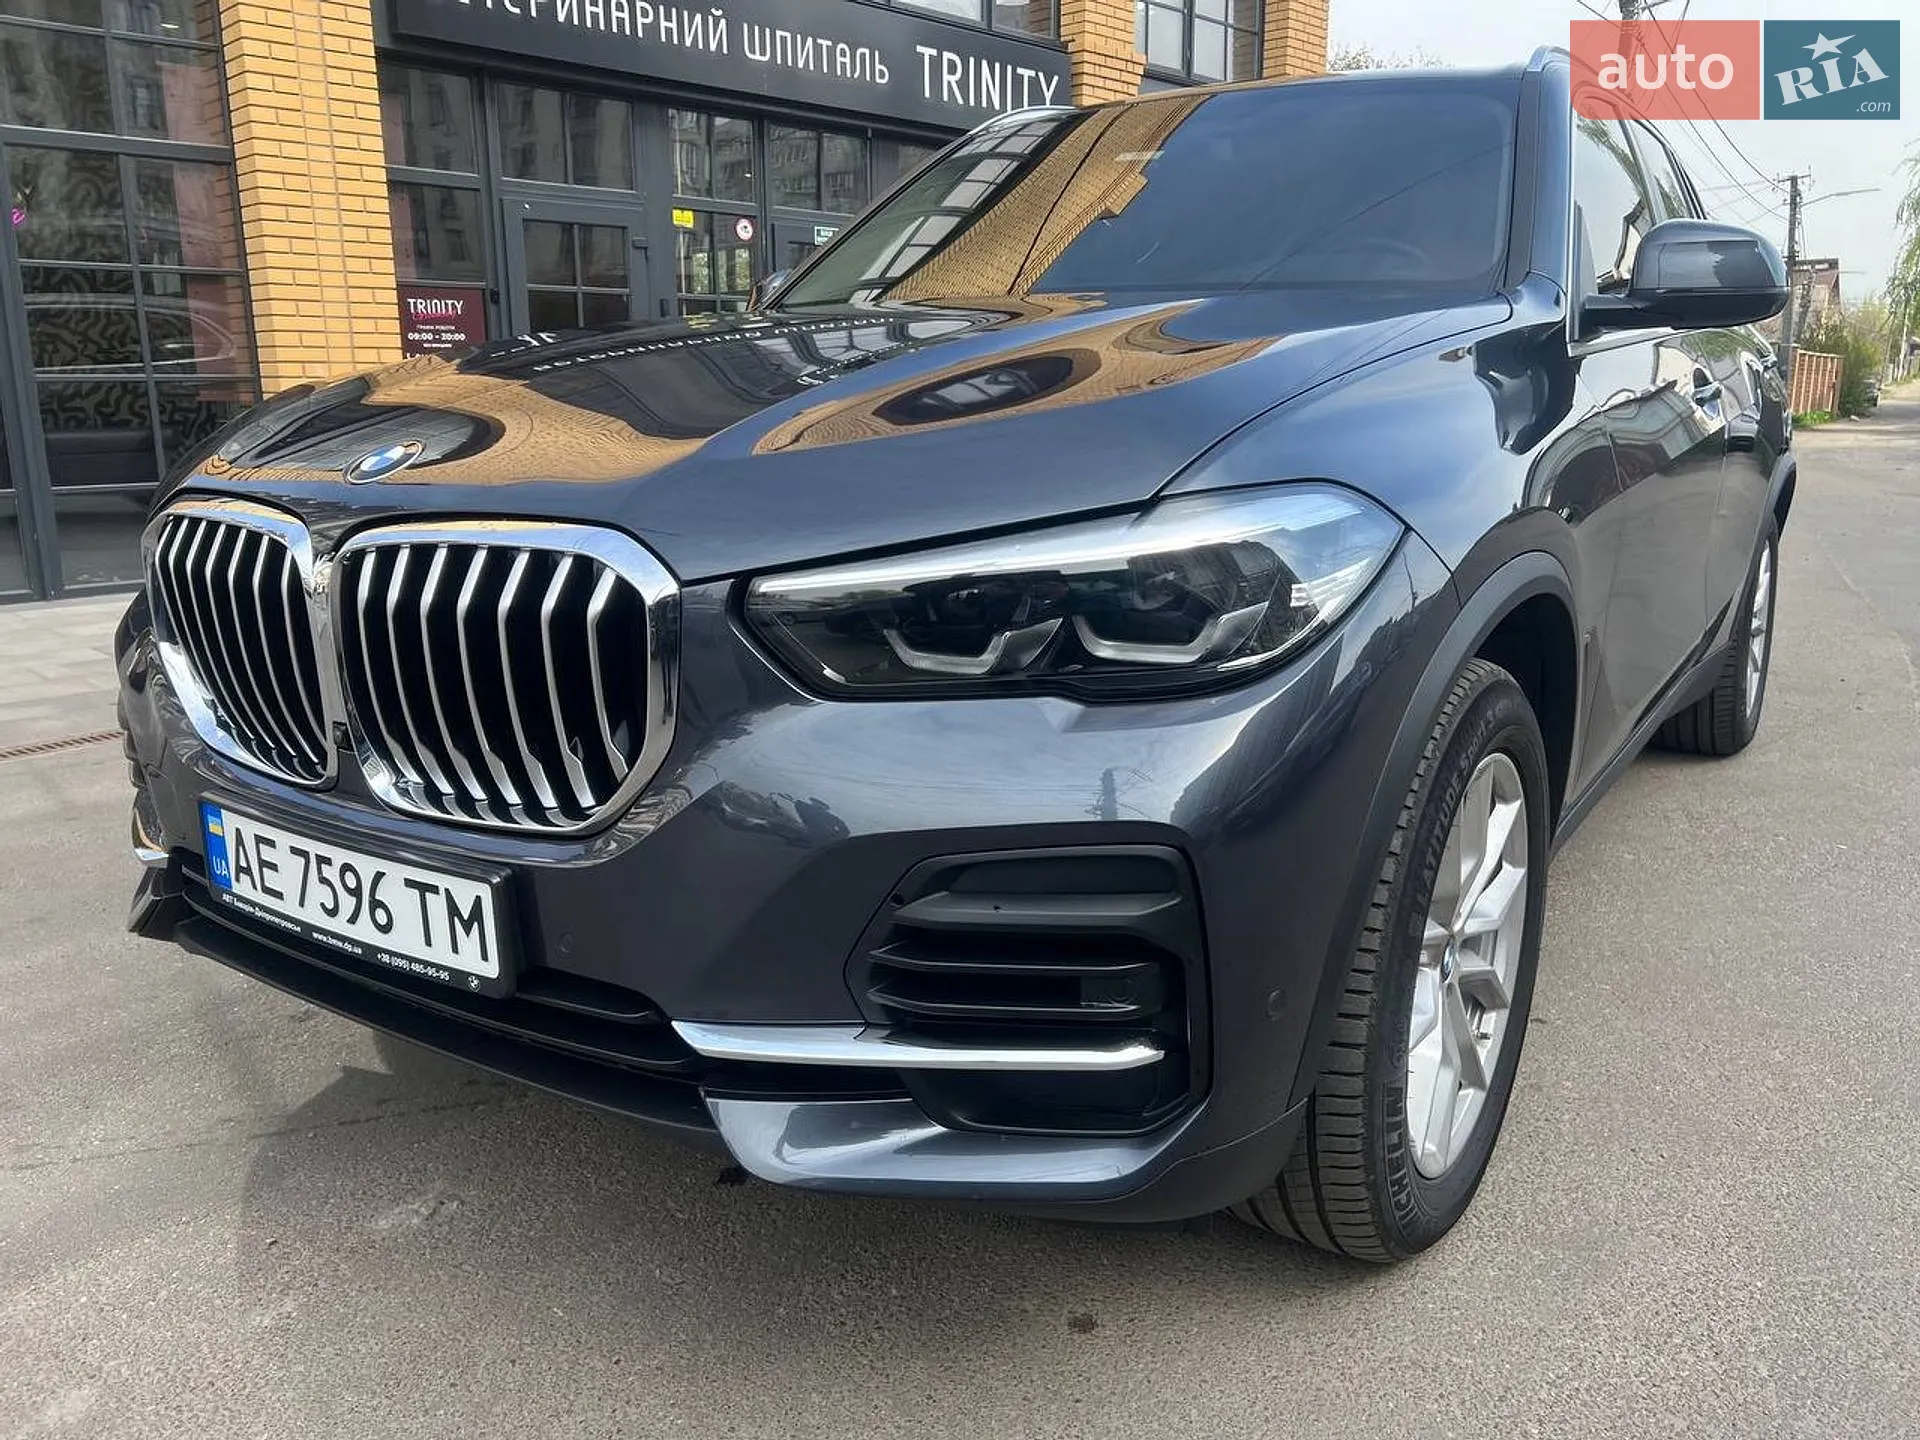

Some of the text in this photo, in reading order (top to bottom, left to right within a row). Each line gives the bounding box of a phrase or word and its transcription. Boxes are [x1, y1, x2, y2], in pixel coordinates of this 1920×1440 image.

[458, 0, 1059, 113] ИНАРНИЙ ШПИТАЛЬ TRINITY
[407, 298, 463, 315] TRINITY
[212, 855, 230, 878] UA
[234, 827, 489, 963] AE 7596 TM
[1382, 1081, 1425, 1232] ICHELIN
